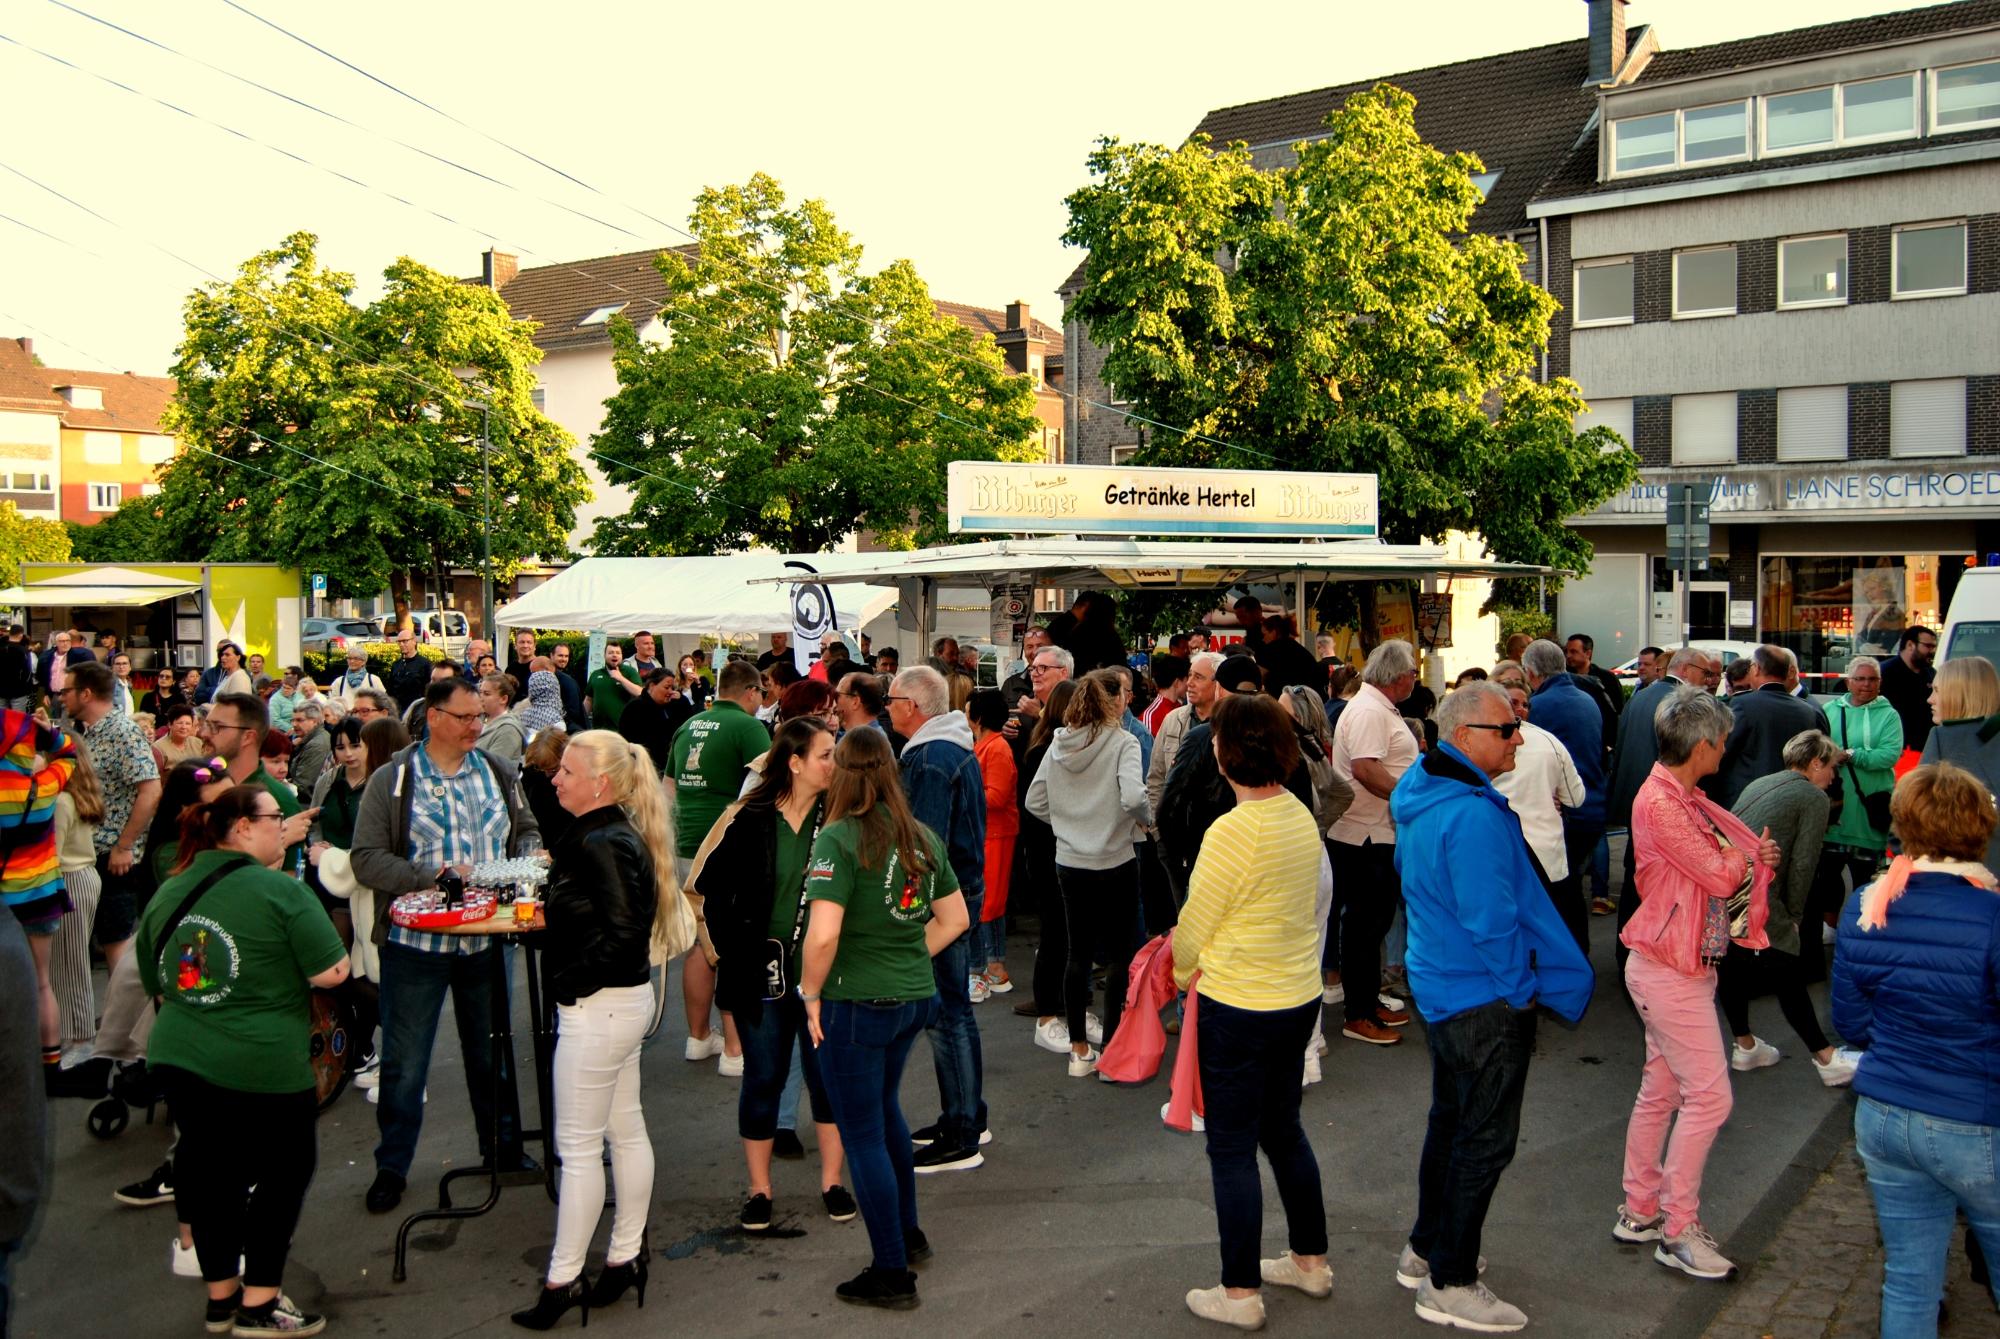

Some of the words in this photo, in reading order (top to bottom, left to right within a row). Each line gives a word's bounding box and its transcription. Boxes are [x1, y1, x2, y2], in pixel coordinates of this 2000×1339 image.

[968, 475, 1078, 518] Bitburger
[1104, 484, 1190, 506] Getränke
[1197, 486, 1255, 508] Hertel
[1786, 477, 1859, 500] LIANE
[1276, 483, 1368, 525] Bitburger
[316, 576, 324, 589] P
[689, 719, 721, 730] Offiziers
[692, 729, 709, 739] Korps
[884, 854, 898, 889] Hubertus
[767, 959, 780, 997] FILA
